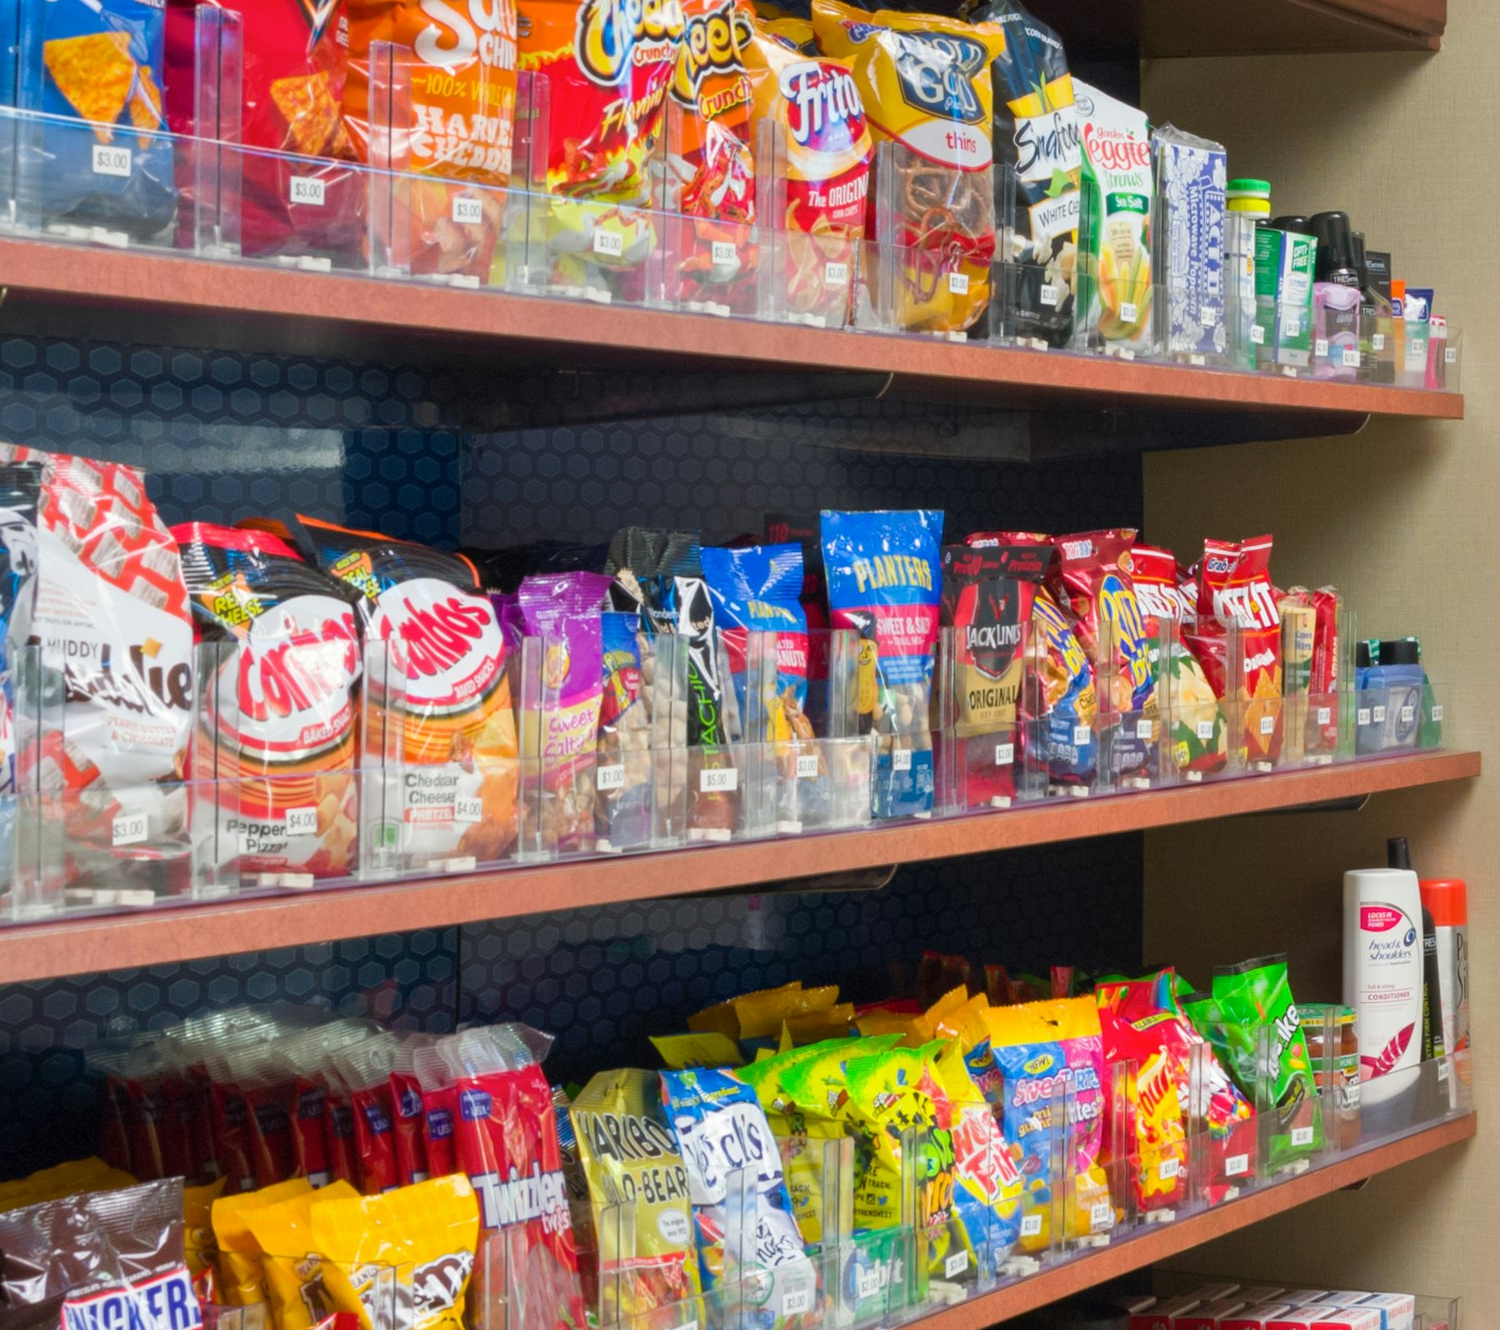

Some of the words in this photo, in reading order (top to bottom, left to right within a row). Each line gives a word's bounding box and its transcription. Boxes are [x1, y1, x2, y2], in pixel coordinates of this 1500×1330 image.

[946, 132, 977, 153] thins
[97, 151, 127, 169] $3.00
[295, 183, 321, 199] $3.00
[457, 203, 480, 219] $3.00
[600, 235, 621, 251] $3.00
[714, 245, 734, 260] $3.00
[950, 276, 966, 289] $3.00
[852, 555, 934, 593] PLANTERS
[799, 759, 817, 772] $3.00
[602, 768, 625, 783] $1.00
[707, 772, 728, 786] $5.00
[456, 801, 482, 816] $4.00
[289, 812, 316, 828] $4.00
[113, 821, 144, 838] $3.00
[1369, 939, 1395, 951] head
[1369, 949, 1412, 960] shoulders
[1368, 991, 1410, 1001] CONDITIONER
[949, 1257, 967, 1273] $3.00
